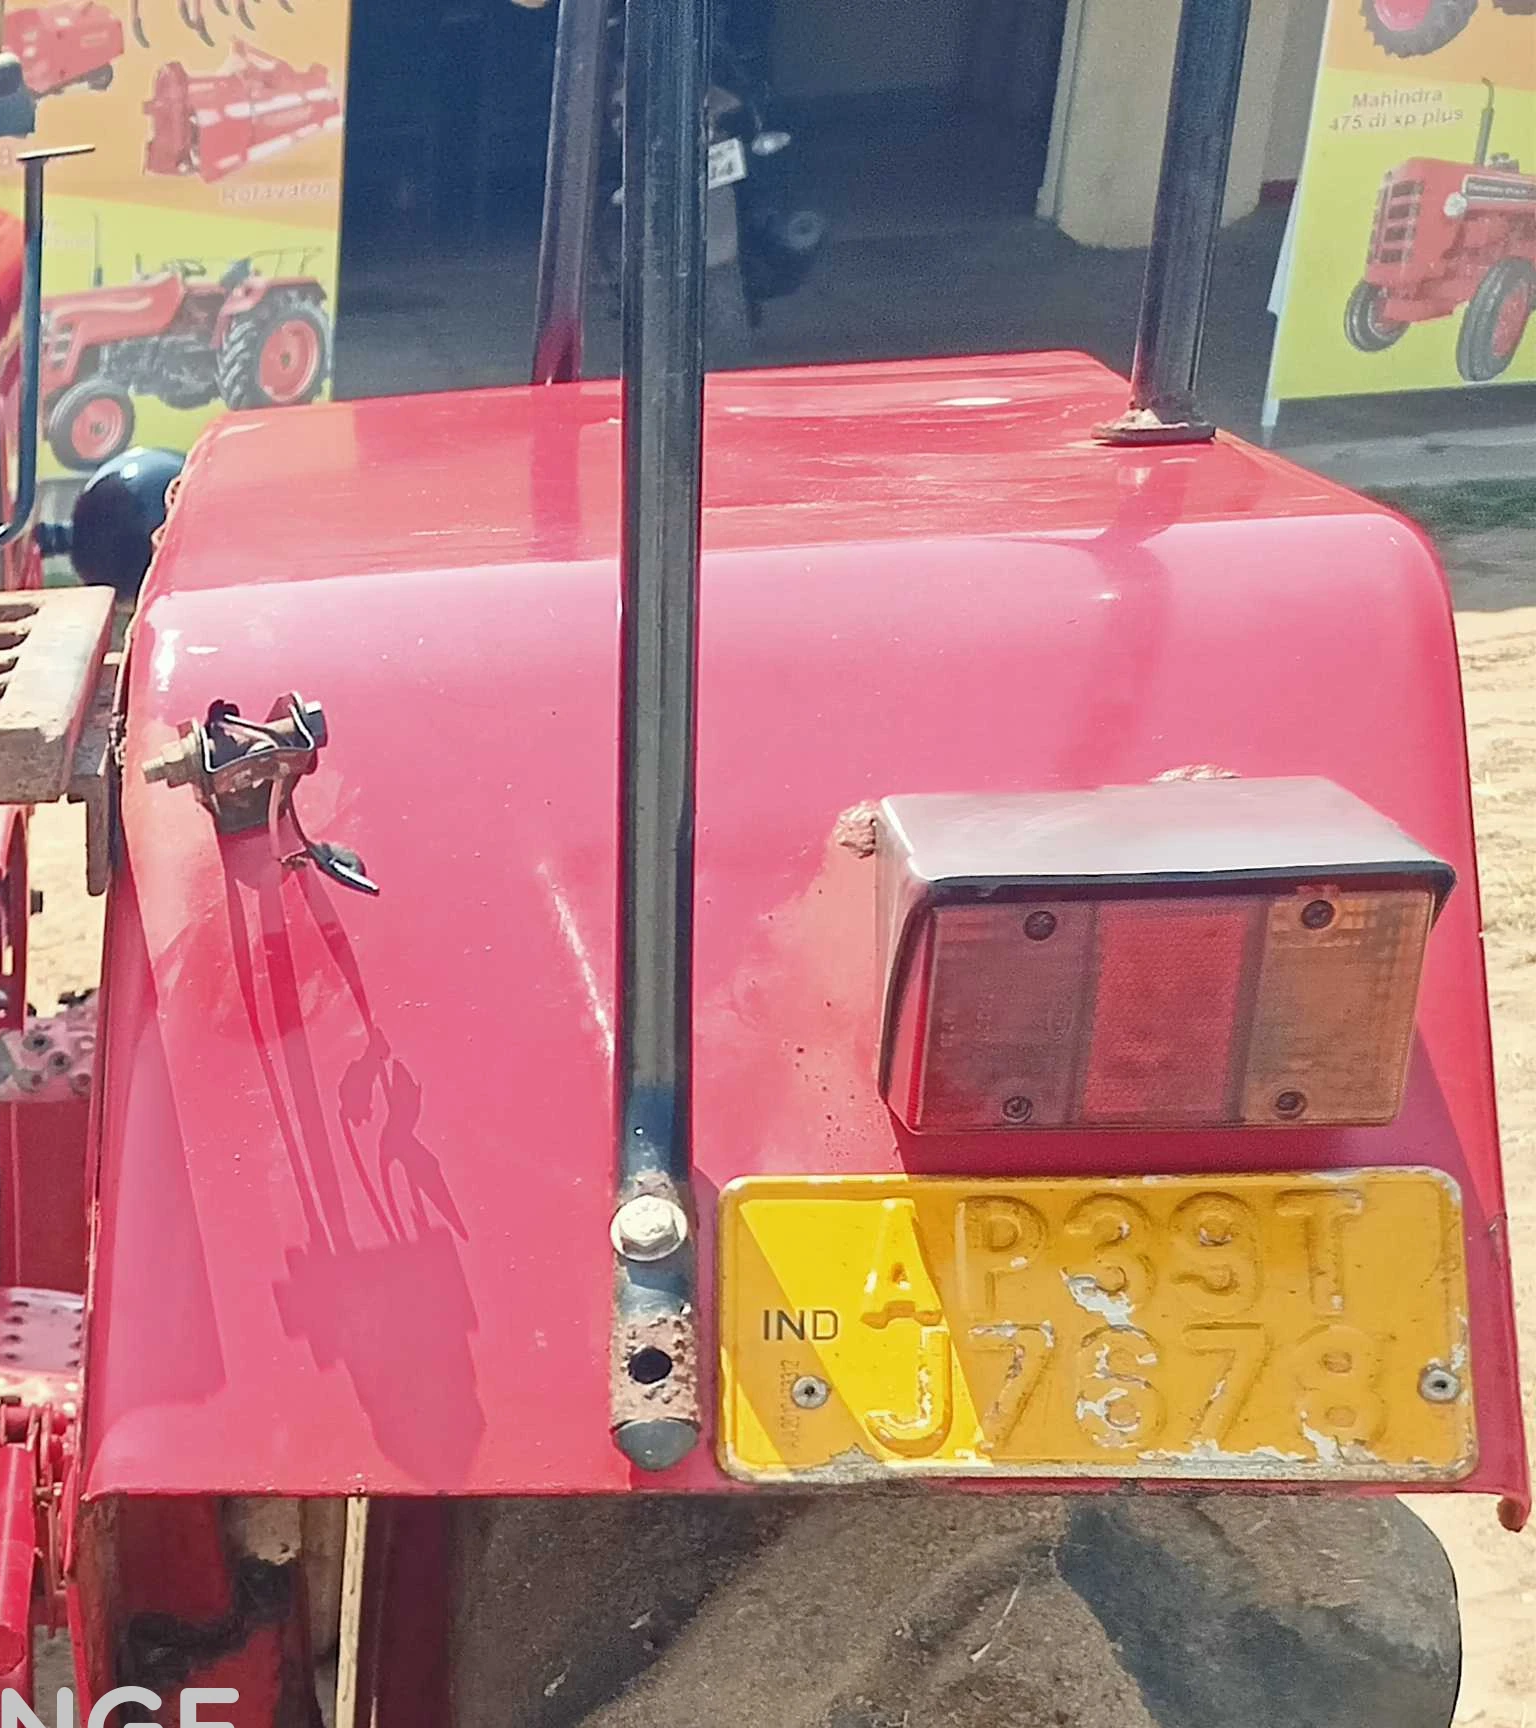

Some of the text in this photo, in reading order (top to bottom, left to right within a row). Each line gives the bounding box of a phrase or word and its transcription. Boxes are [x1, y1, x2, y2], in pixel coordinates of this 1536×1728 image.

[1352, 88, 1443, 109] Mahindra
[1422, 107, 1464, 127] plus
[861, 1188, 1364, 1330] AP39T
[762, 1308, 839, 1342] IND
[865, 1320, 1391, 1458] J7678
